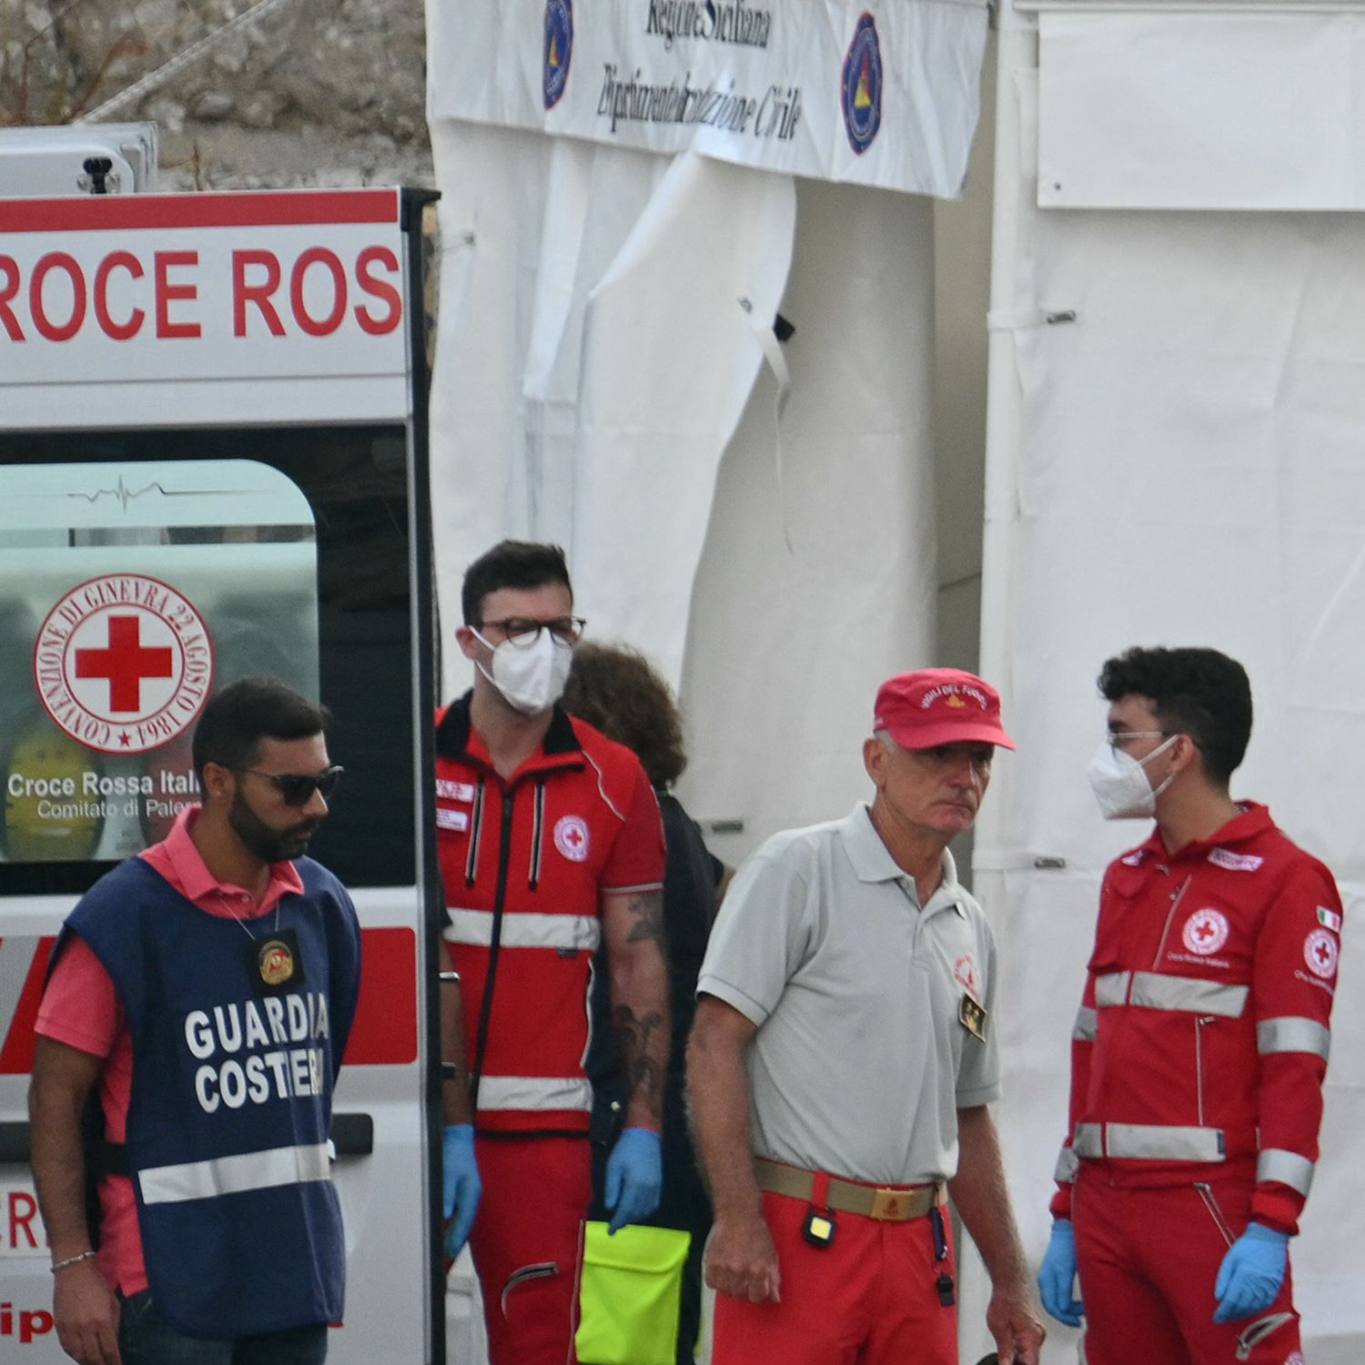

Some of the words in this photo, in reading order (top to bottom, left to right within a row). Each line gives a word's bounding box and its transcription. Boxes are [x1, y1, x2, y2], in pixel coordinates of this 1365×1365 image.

[232, 245, 402, 338] ROS
[84, 578, 169, 613] GINEVRA
[167, 603, 195, 631] 22
[7, 773, 76, 797] Croce
[83, 771, 153, 796] Rossa
[37, 800, 119, 819] Comitato
[123, 801, 139, 817] di
[184, 992, 330, 1060] GUARDIA
